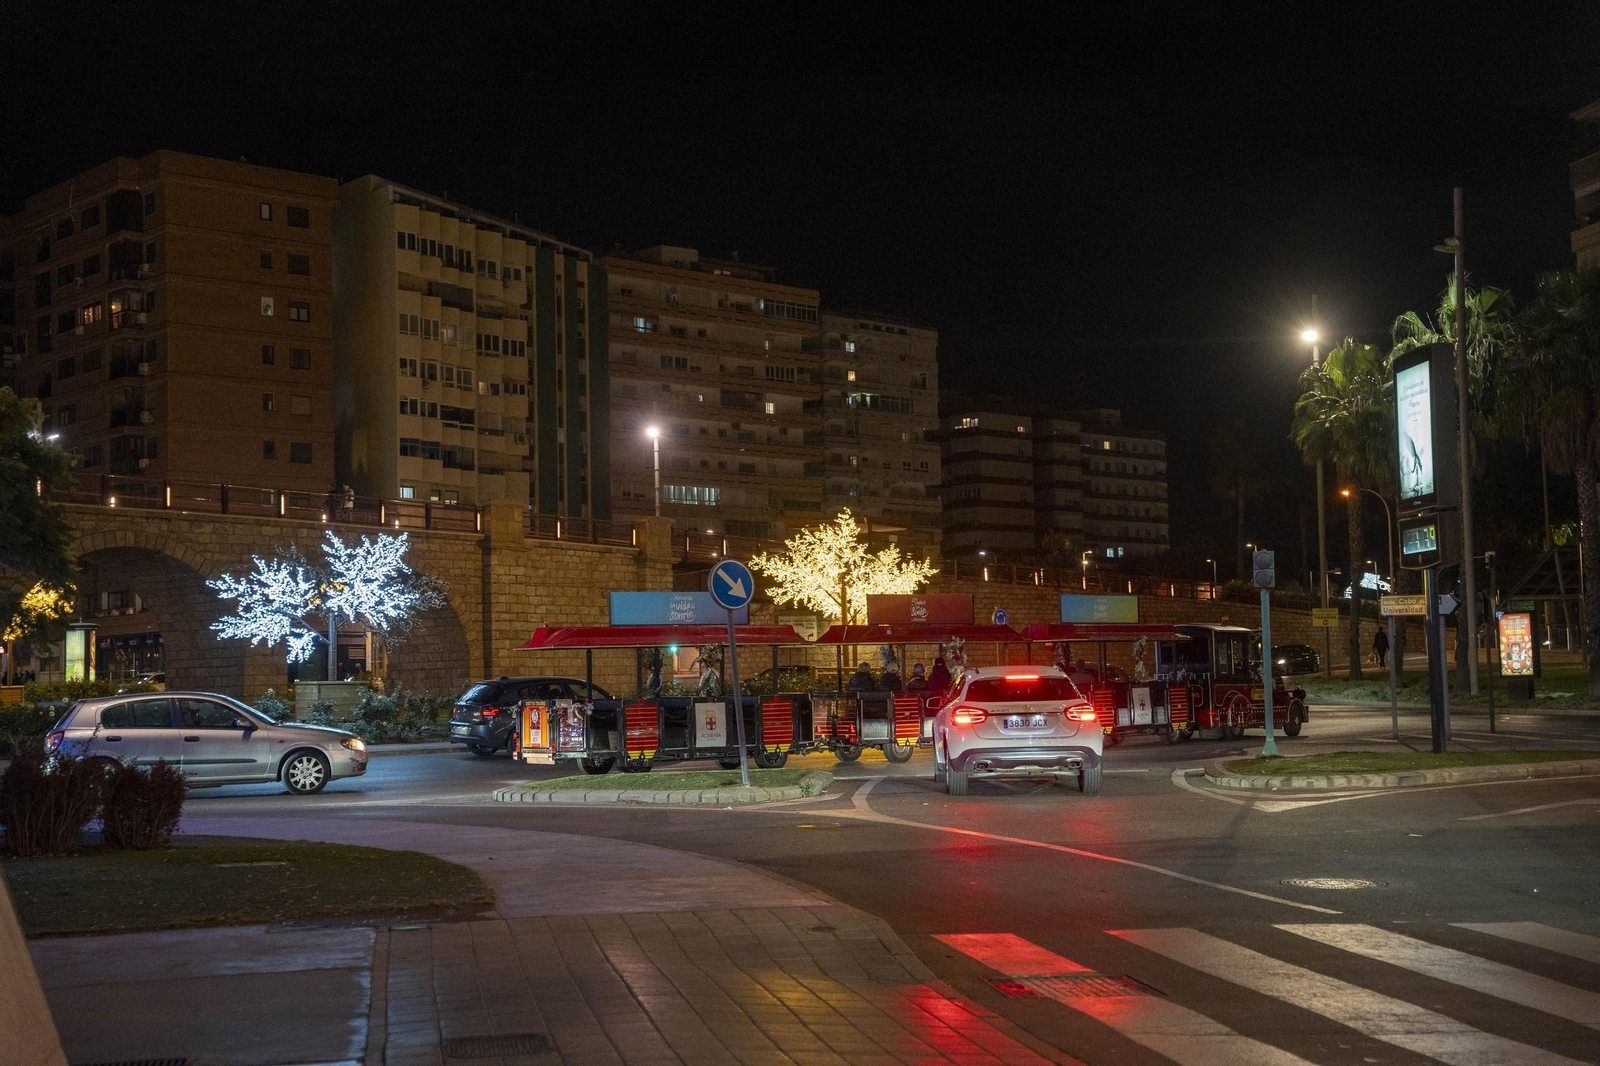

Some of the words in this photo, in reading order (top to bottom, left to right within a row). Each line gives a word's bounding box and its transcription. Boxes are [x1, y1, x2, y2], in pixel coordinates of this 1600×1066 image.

[675, 601, 690, 610] vida
[1009, 719, 1030, 727] 3830
[1032, 719, 1048, 727] JCX
